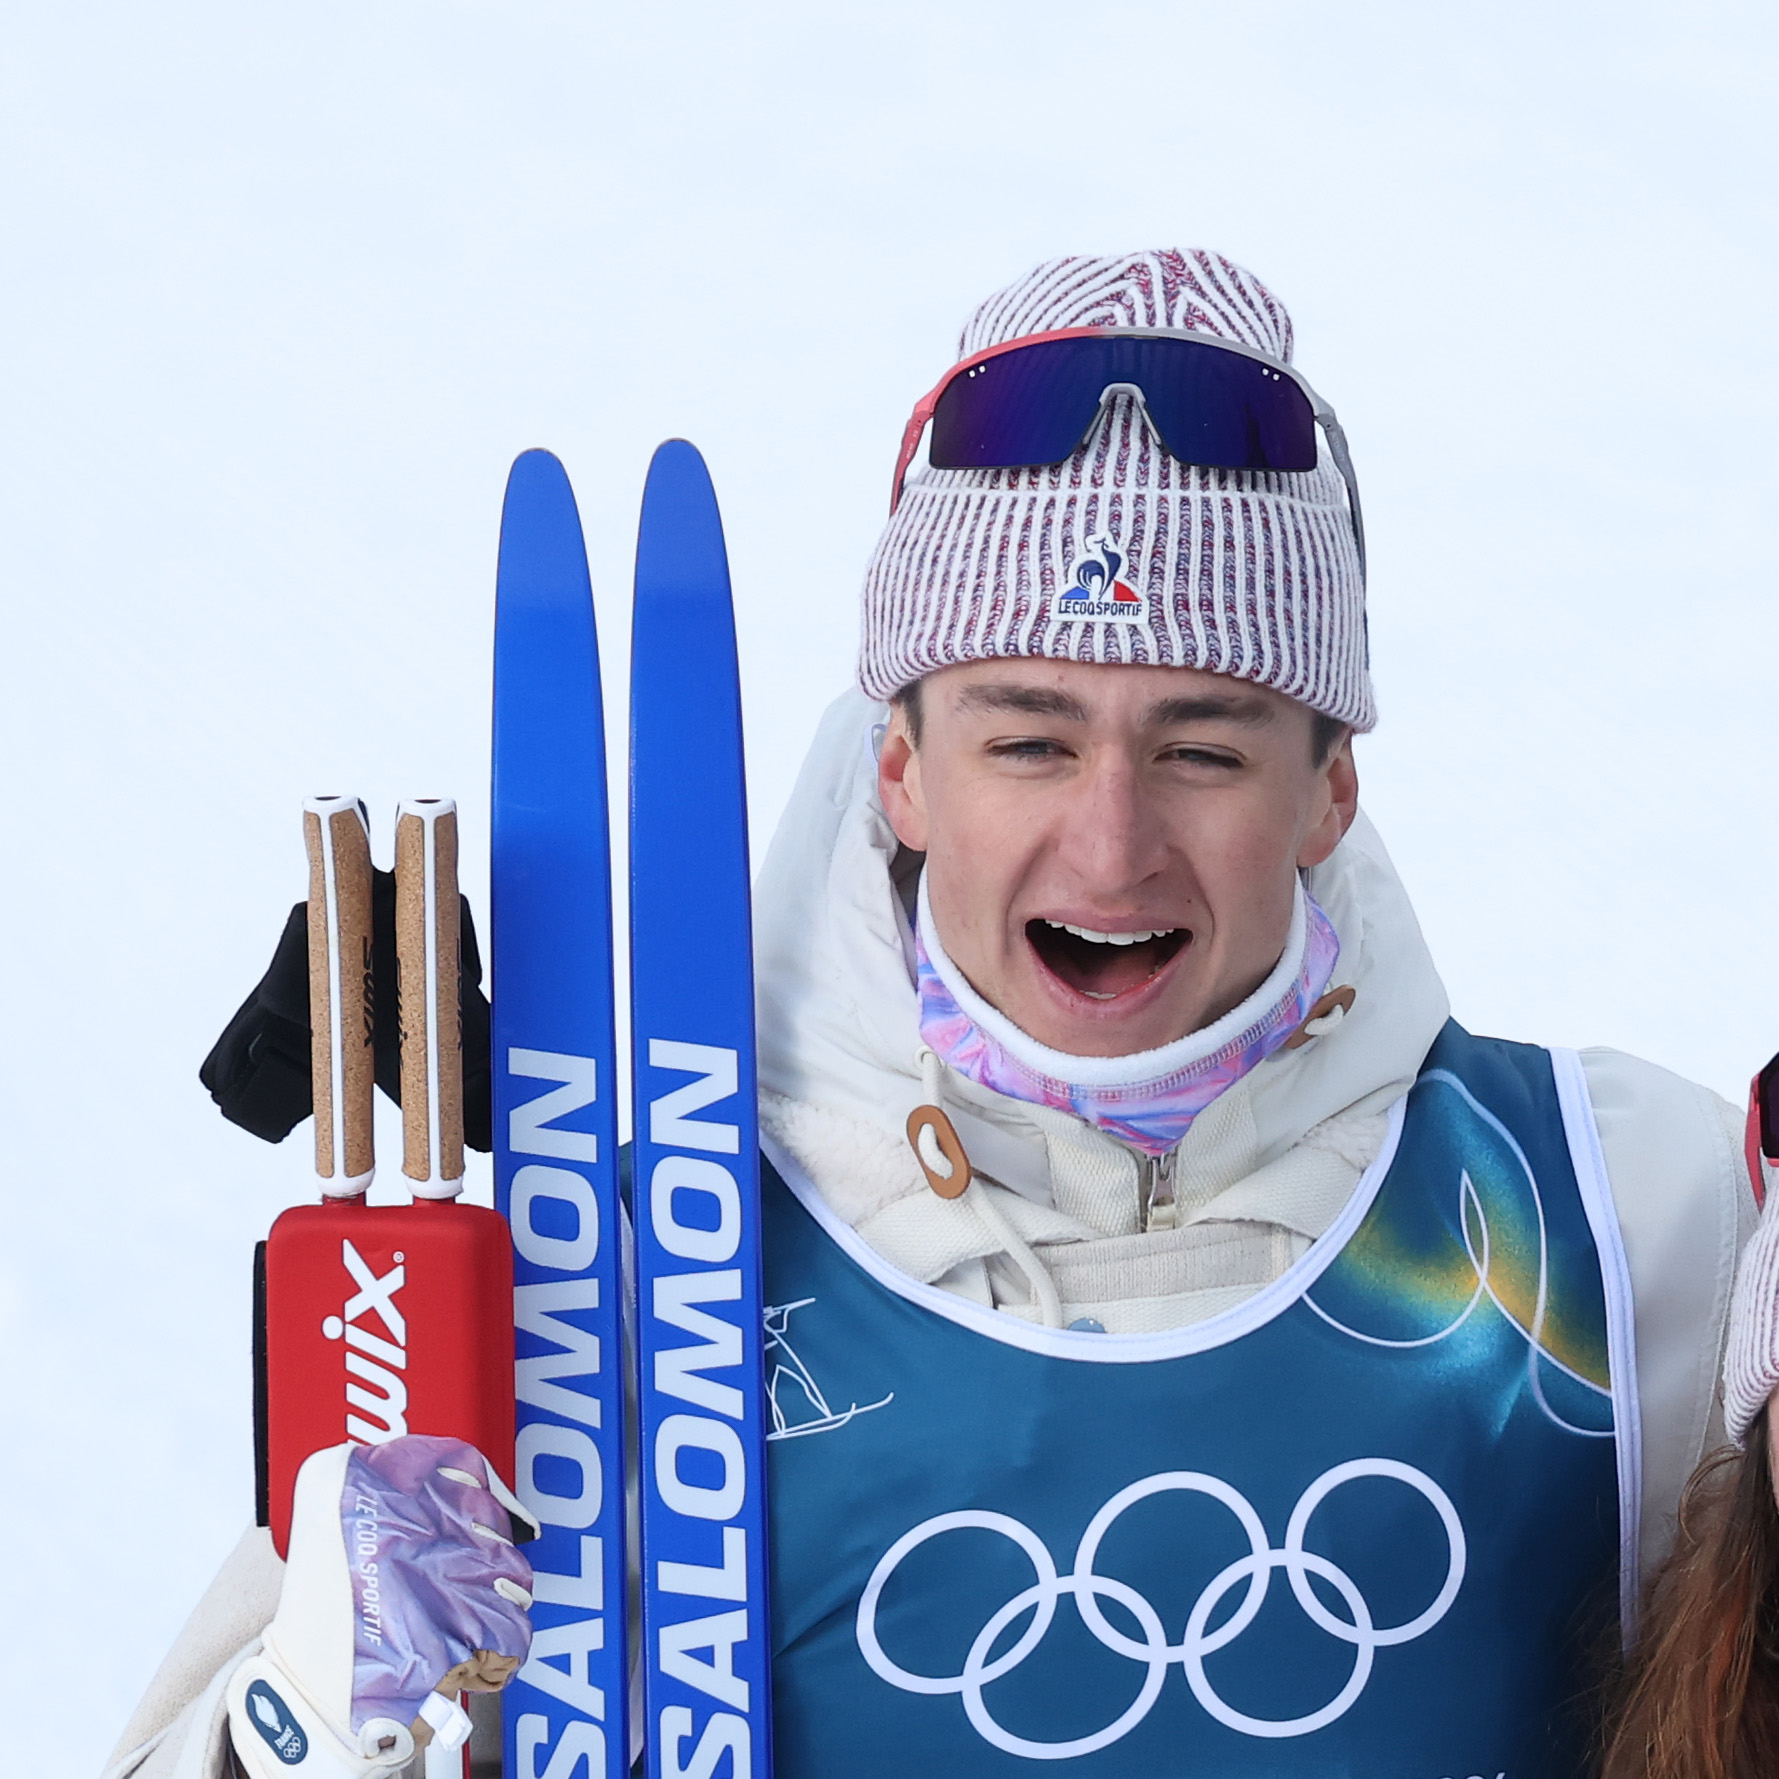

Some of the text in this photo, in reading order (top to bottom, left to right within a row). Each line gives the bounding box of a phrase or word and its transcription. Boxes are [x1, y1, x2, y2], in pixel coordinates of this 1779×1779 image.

[1058, 601, 1142, 616] LE COQ SPORTIF
[321, 1238, 408, 1448] wix
[355, 1519, 378, 1556] COQ
[360, 1562, 382, 1646] SPORTIF
